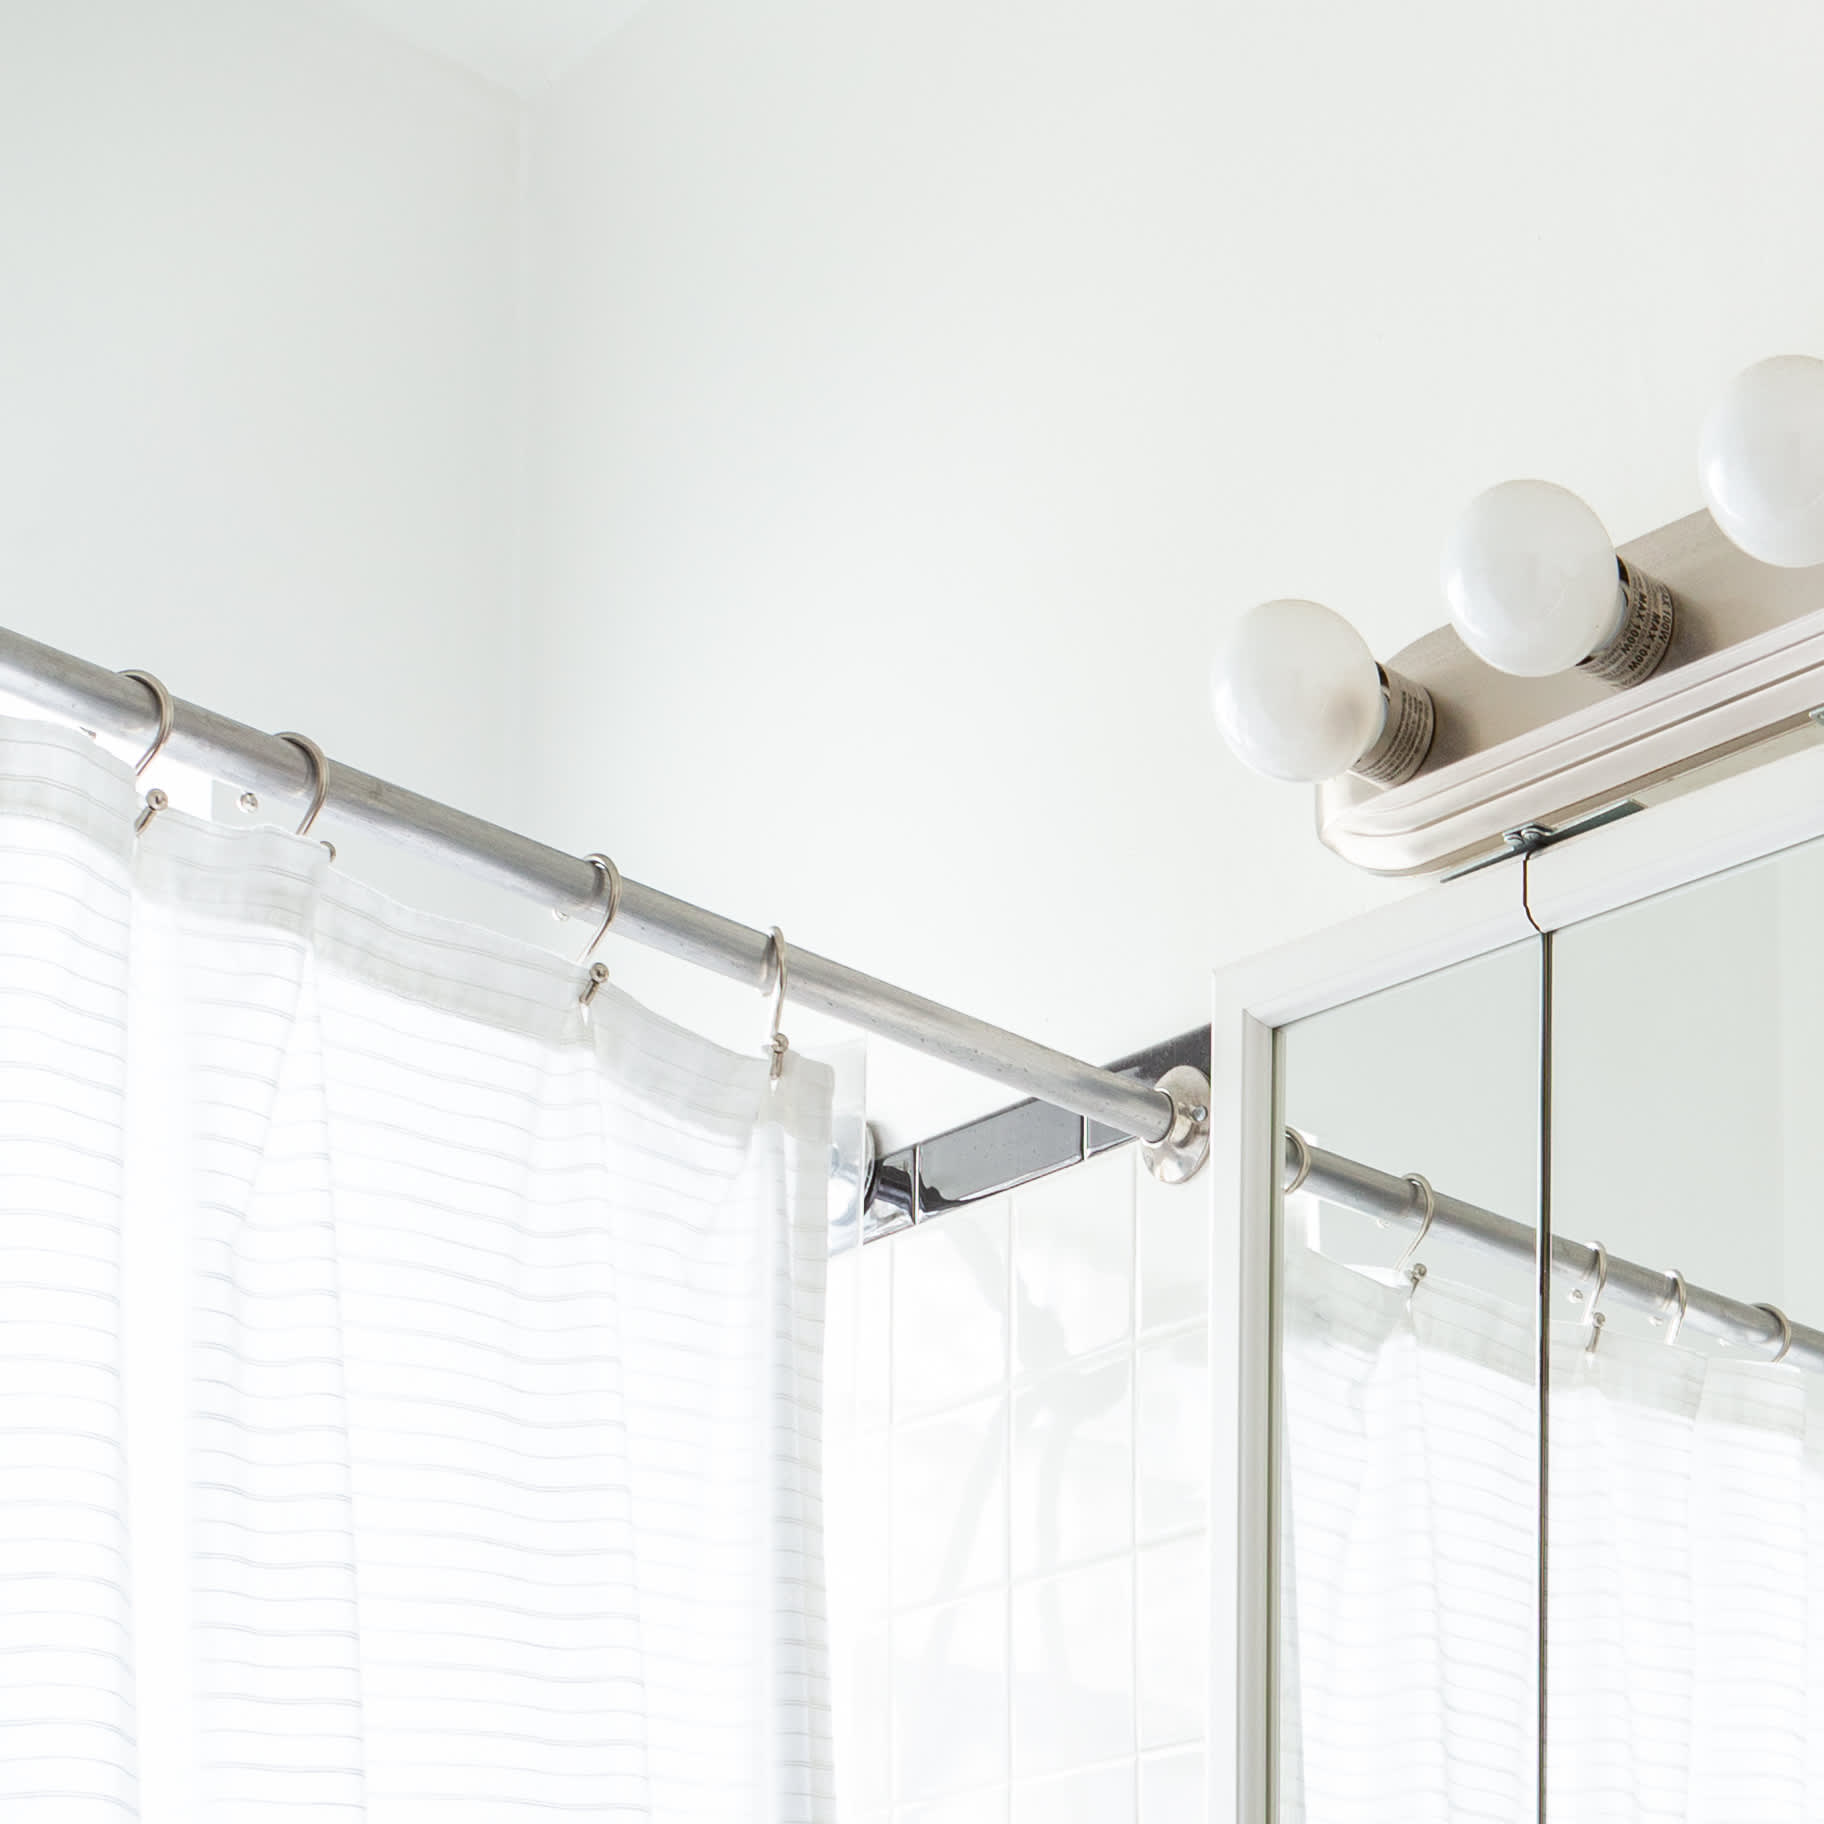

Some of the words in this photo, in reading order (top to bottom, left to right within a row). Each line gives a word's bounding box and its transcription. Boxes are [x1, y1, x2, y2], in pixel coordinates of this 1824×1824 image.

[1620, 625, 1641, 655] 100W
[1648, 611, 1661, 641] MAX
[1628, 643, 1651, 671] 100W
